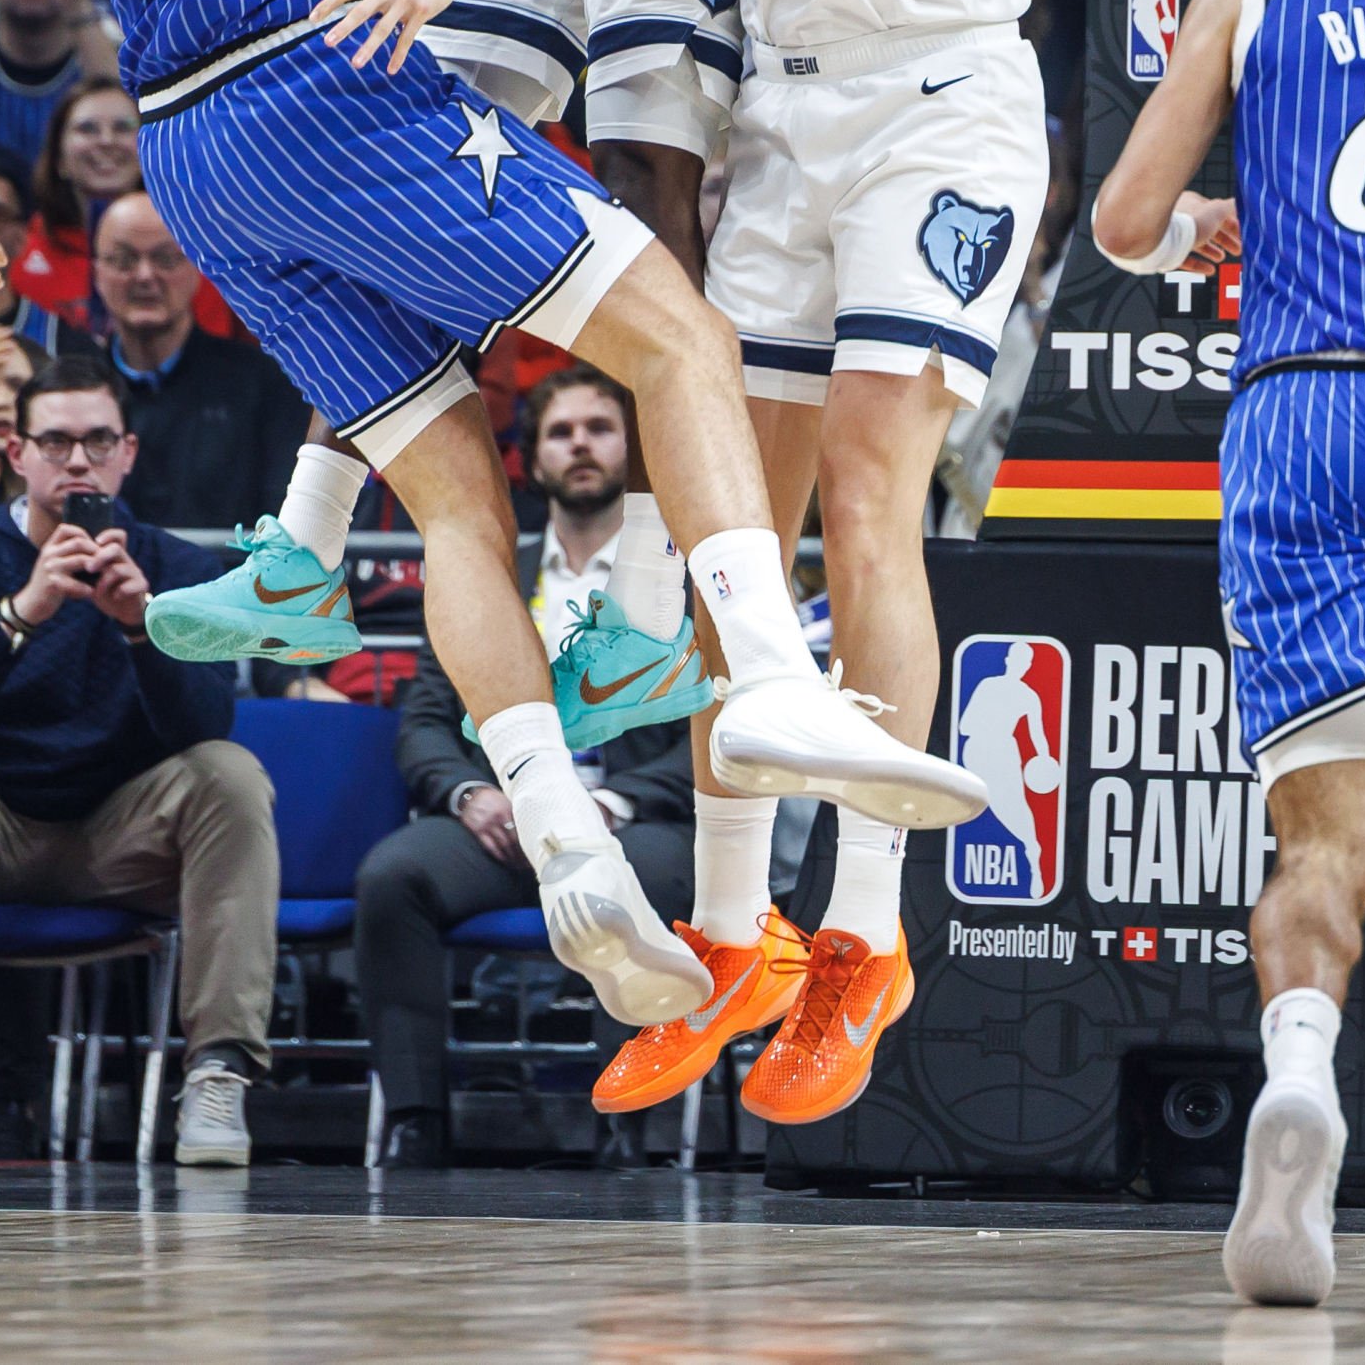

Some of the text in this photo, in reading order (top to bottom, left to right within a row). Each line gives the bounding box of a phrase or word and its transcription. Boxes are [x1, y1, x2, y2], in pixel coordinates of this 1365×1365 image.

[1134, 53, 1160, 74] NBA
[964, 843, 1019, 887] NBA
[948, 920, 1050, 960] Presented
[1052, 923, 1077, 966] by
